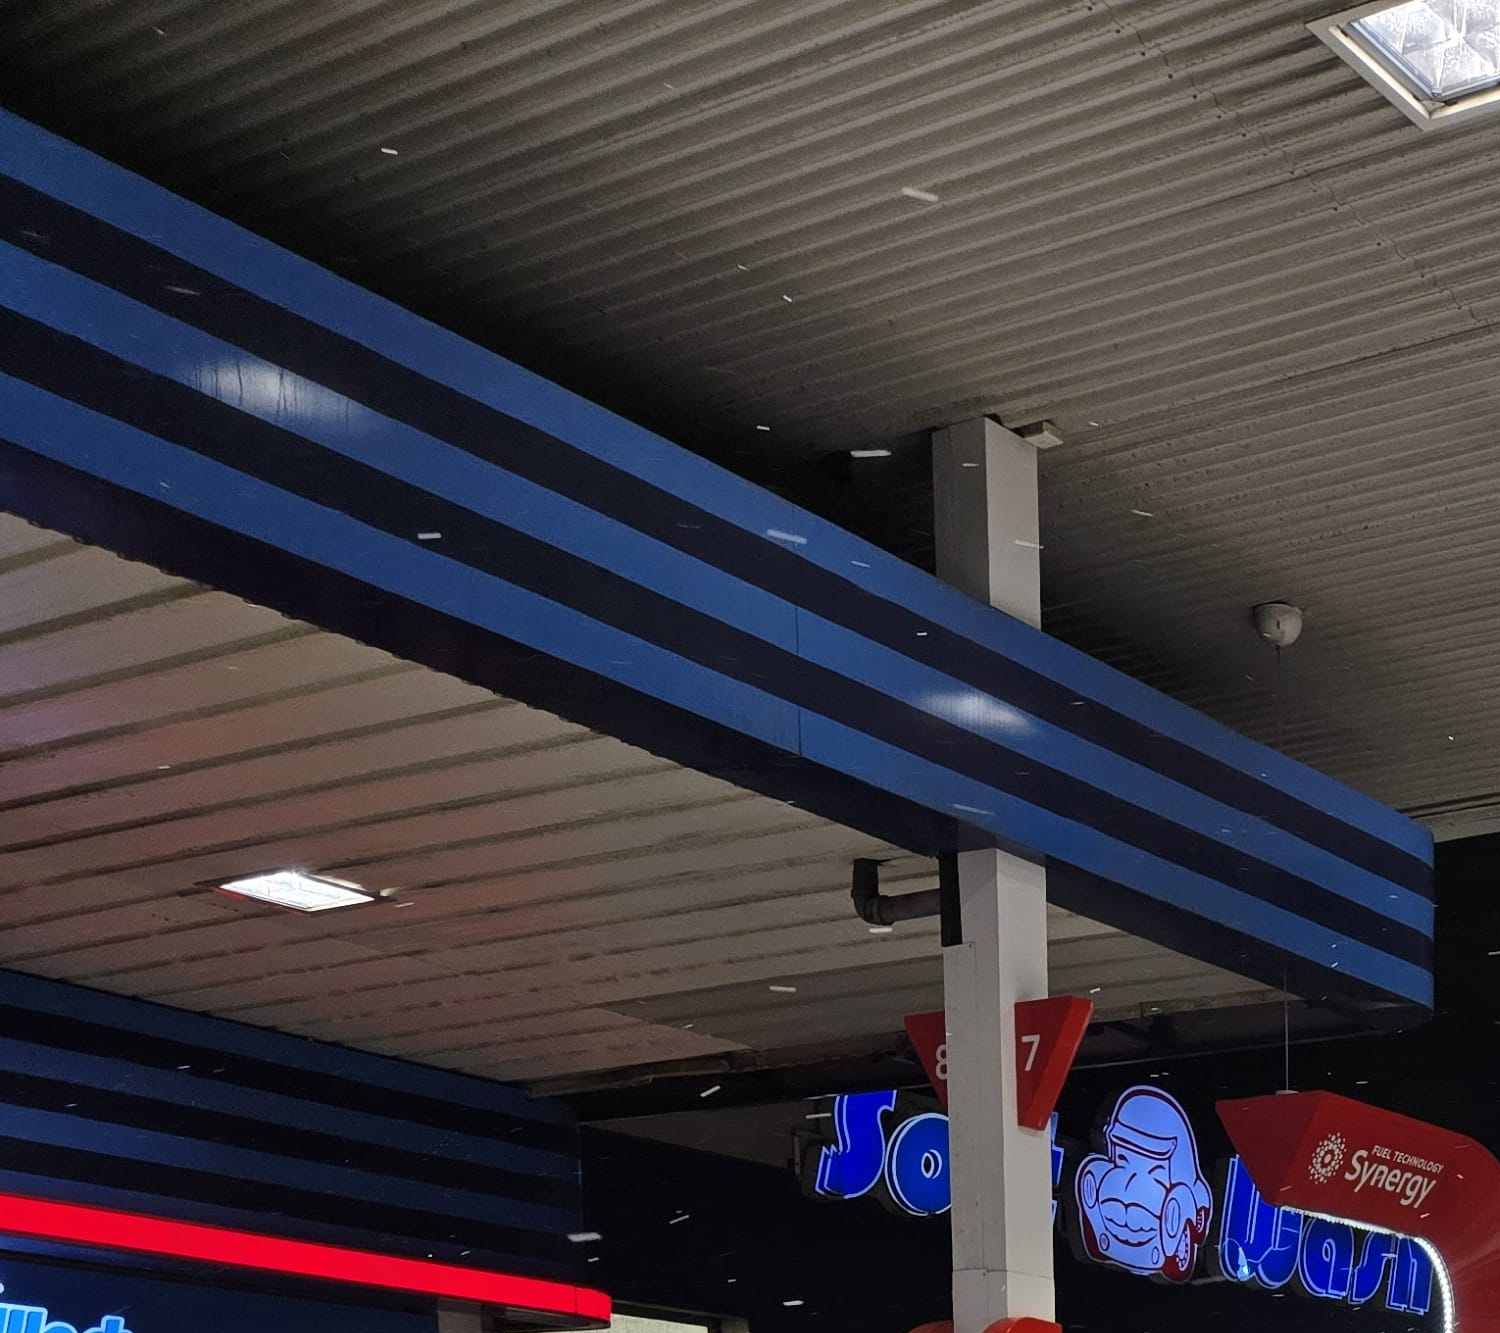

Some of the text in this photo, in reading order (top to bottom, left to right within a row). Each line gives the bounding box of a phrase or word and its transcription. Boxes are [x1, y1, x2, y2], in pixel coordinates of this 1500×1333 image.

[1021, 1034, 1041, 1072] 7
[1372, 1145, 1445, 1174] FUEL TECHNOLOGY
[1344, 1149, 1437, 1209] Synergy
